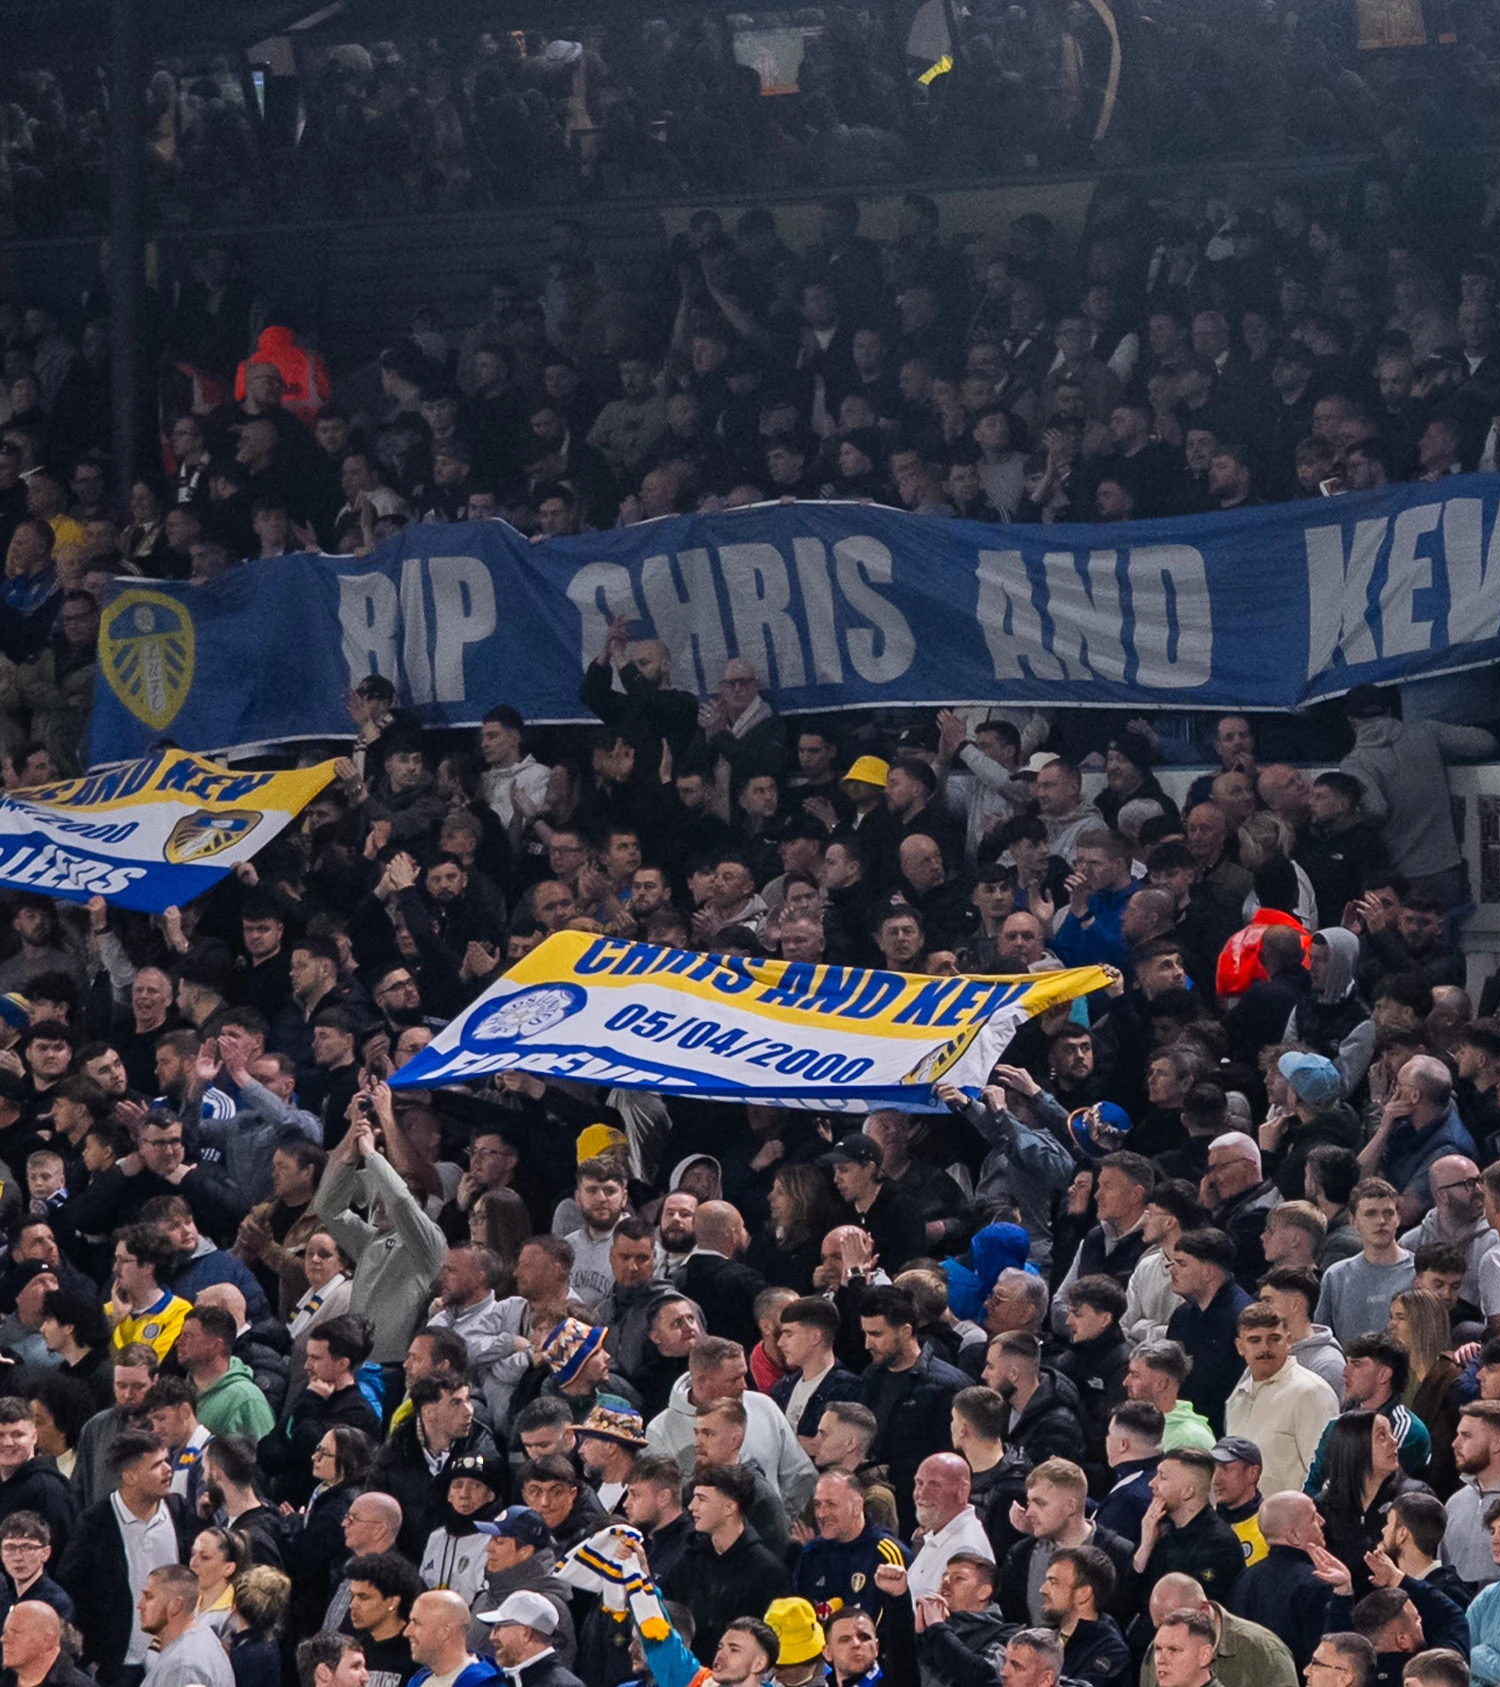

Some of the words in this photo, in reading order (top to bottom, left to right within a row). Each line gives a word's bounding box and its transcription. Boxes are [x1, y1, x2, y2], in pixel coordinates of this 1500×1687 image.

[337, 556, 497, 706] RIP
[566, 535, 916, 695] CHRIS
[975, 544, 1213, 688] AND
[155, 757, 275, 802] KEV
[755, 962, 907, 1020] AND
[892, 977, 1035, 1027] KEV
[604, 1003, 875, 1085] 05/04/2000
